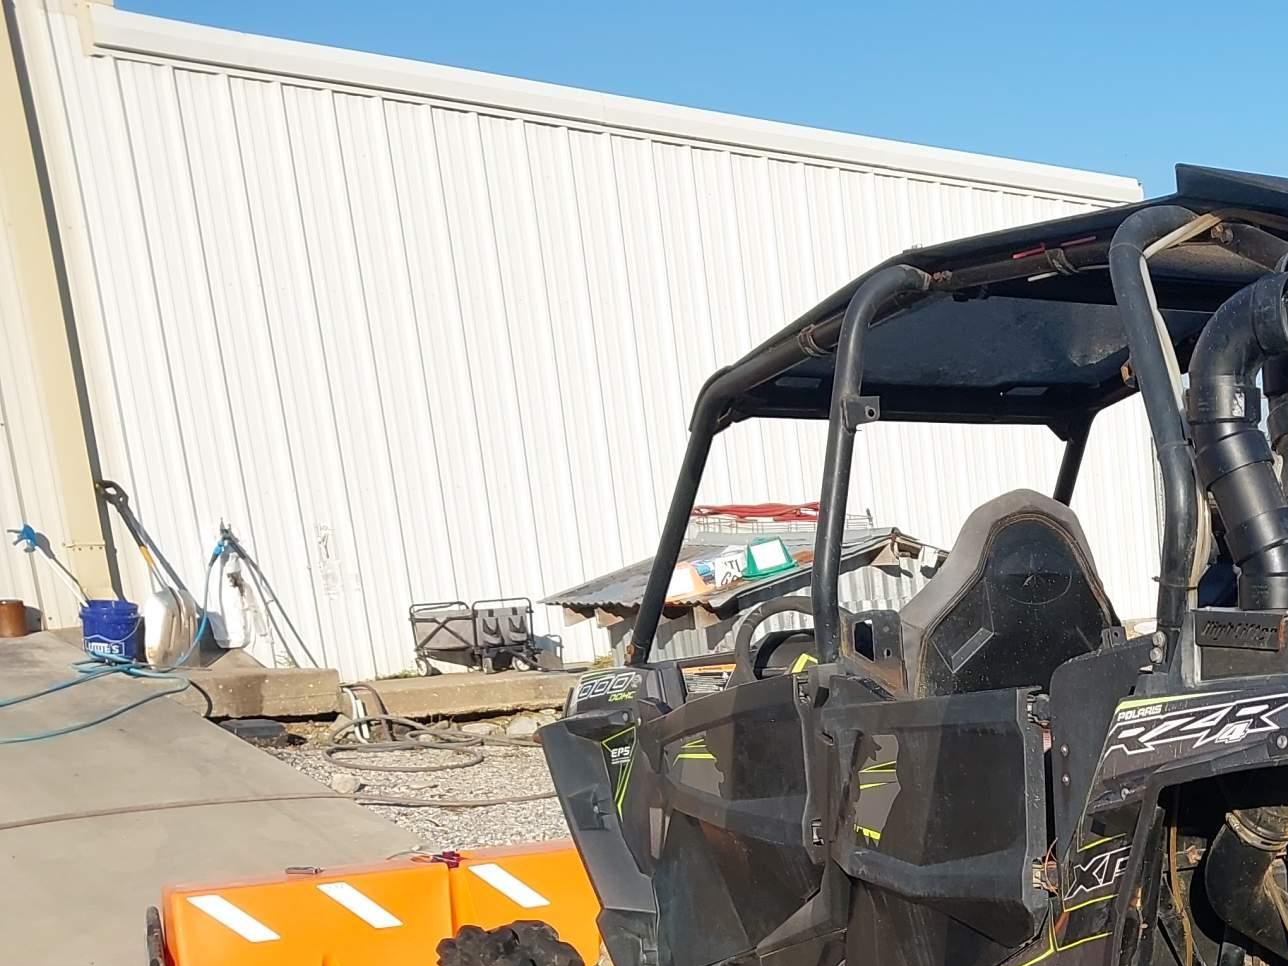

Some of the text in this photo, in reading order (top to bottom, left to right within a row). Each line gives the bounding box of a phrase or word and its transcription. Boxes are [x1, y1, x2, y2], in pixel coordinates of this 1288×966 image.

[1117, 704, 1162, 722] POLARIS
[1214, 718, 1254, 744] 4
[610, 746, 631, 758] EPS
